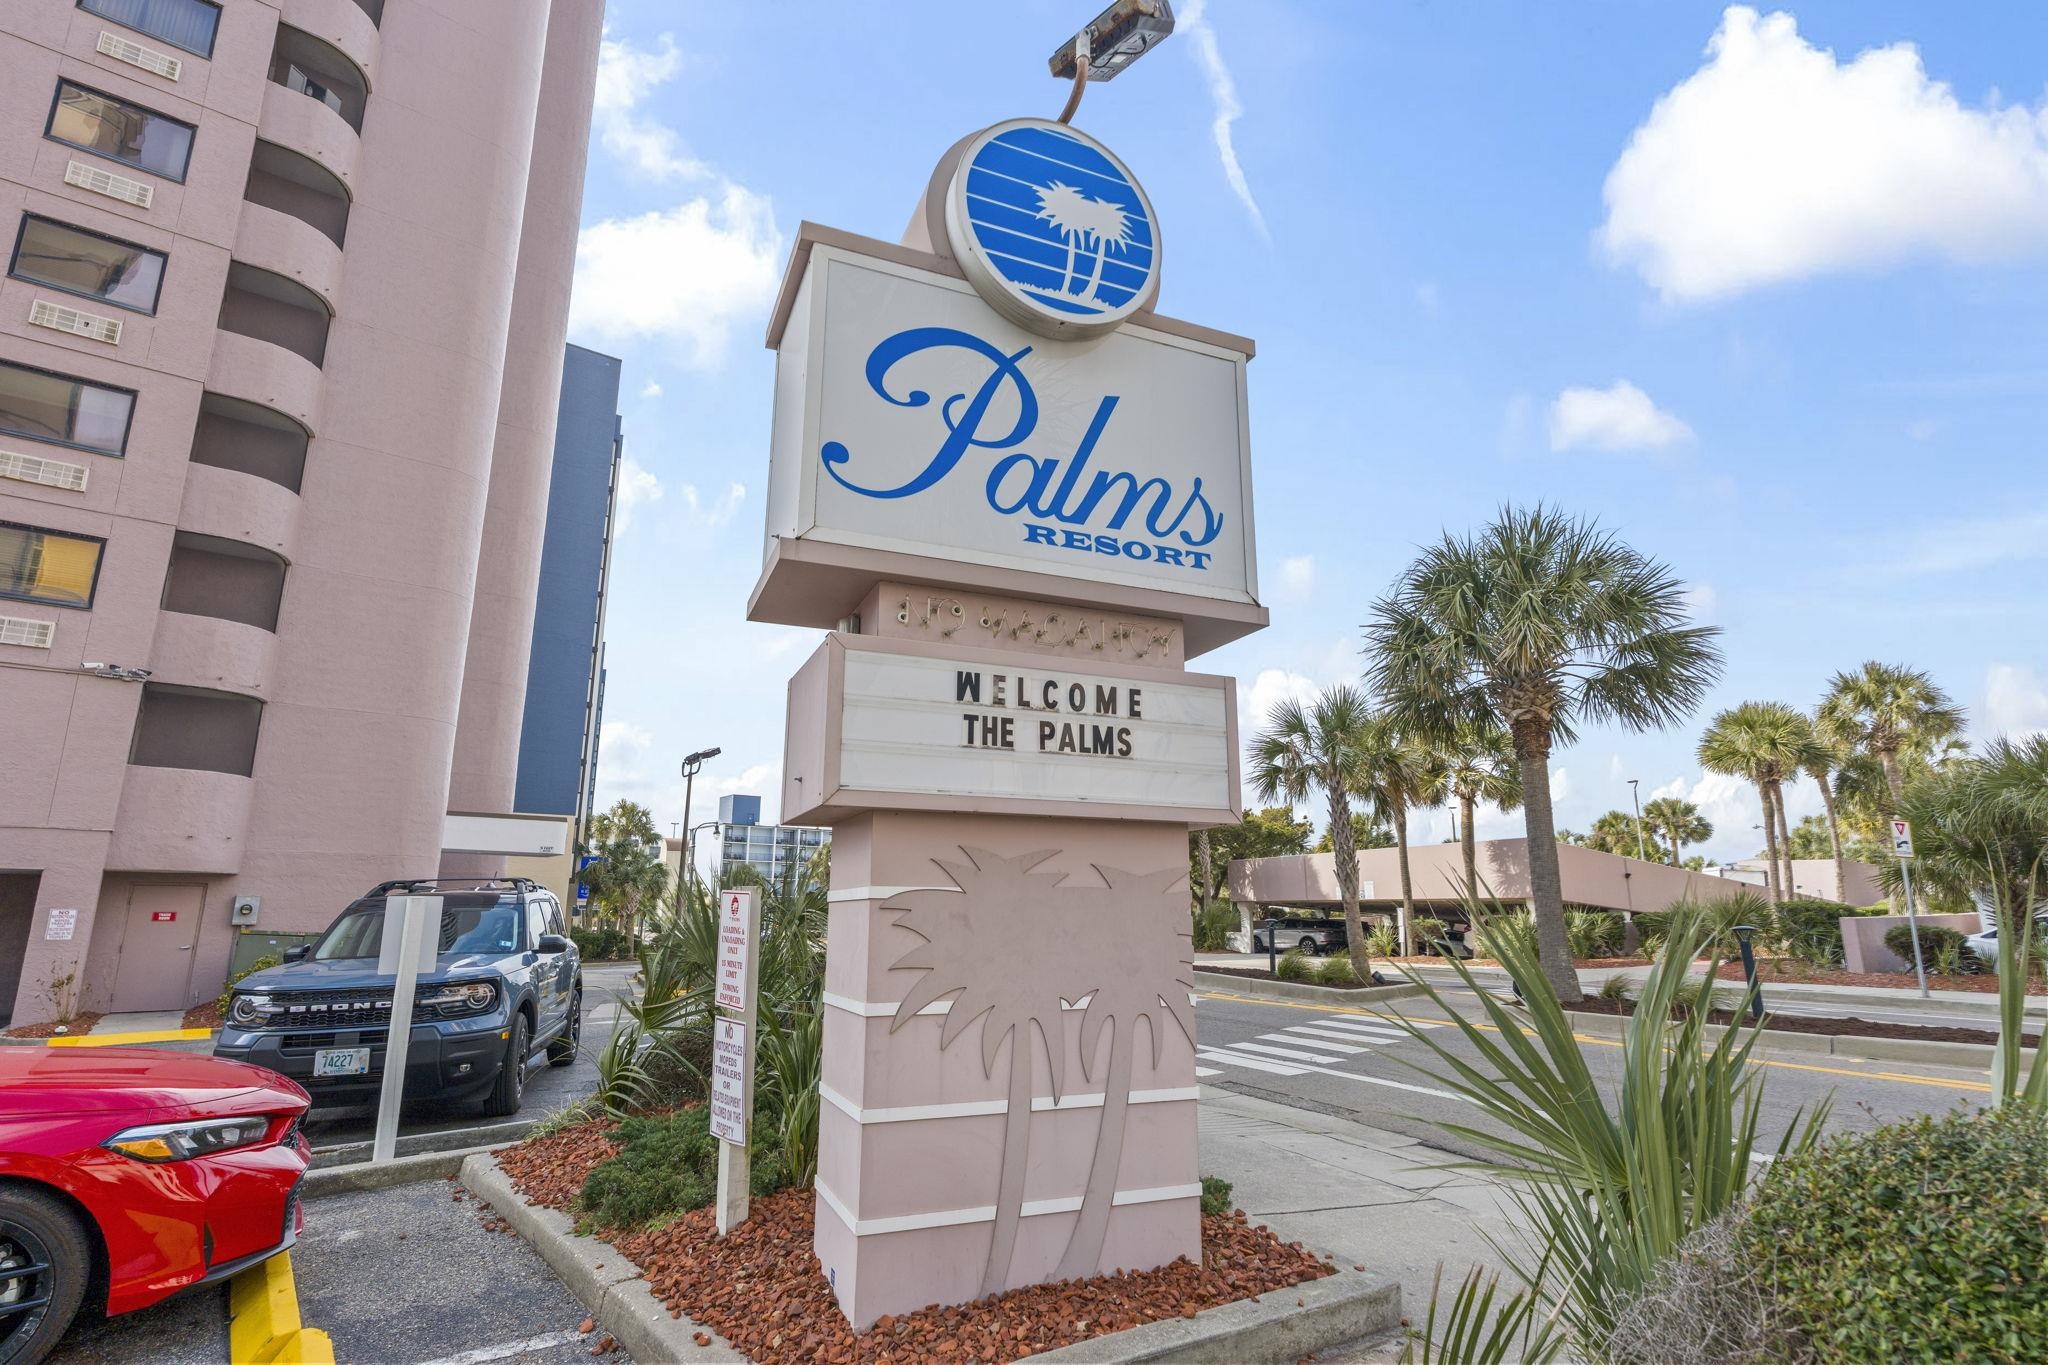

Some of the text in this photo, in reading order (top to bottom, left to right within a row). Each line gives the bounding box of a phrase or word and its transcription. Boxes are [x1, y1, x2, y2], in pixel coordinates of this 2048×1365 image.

[821, 327, 1224, 547] Palms
[1023, 523, 1211, 570] RESORT
[956, 670, 1142, 718] WELCOME
[963, 713, 1133, 757] THE PALMS
[722, 926, 741, 935] LOADING
[721, 935, 745, 945] UNLOADING
[727, 960, 743, 970] MINUTE
[725, 970, 737, 979] LIMIT
[720, 993, 741, 1004] ENFORCED
[290, 1001, 393, 1013] BRONC
[725, 1025, 734, 1039] NO
[321, 1054, 354, 1068] 74227
[720, 1055, 737, 1067] MOPEDS
[714, 1065, 742, 1081] TRAILERS
[723, 1081, 731, 1090] OR
